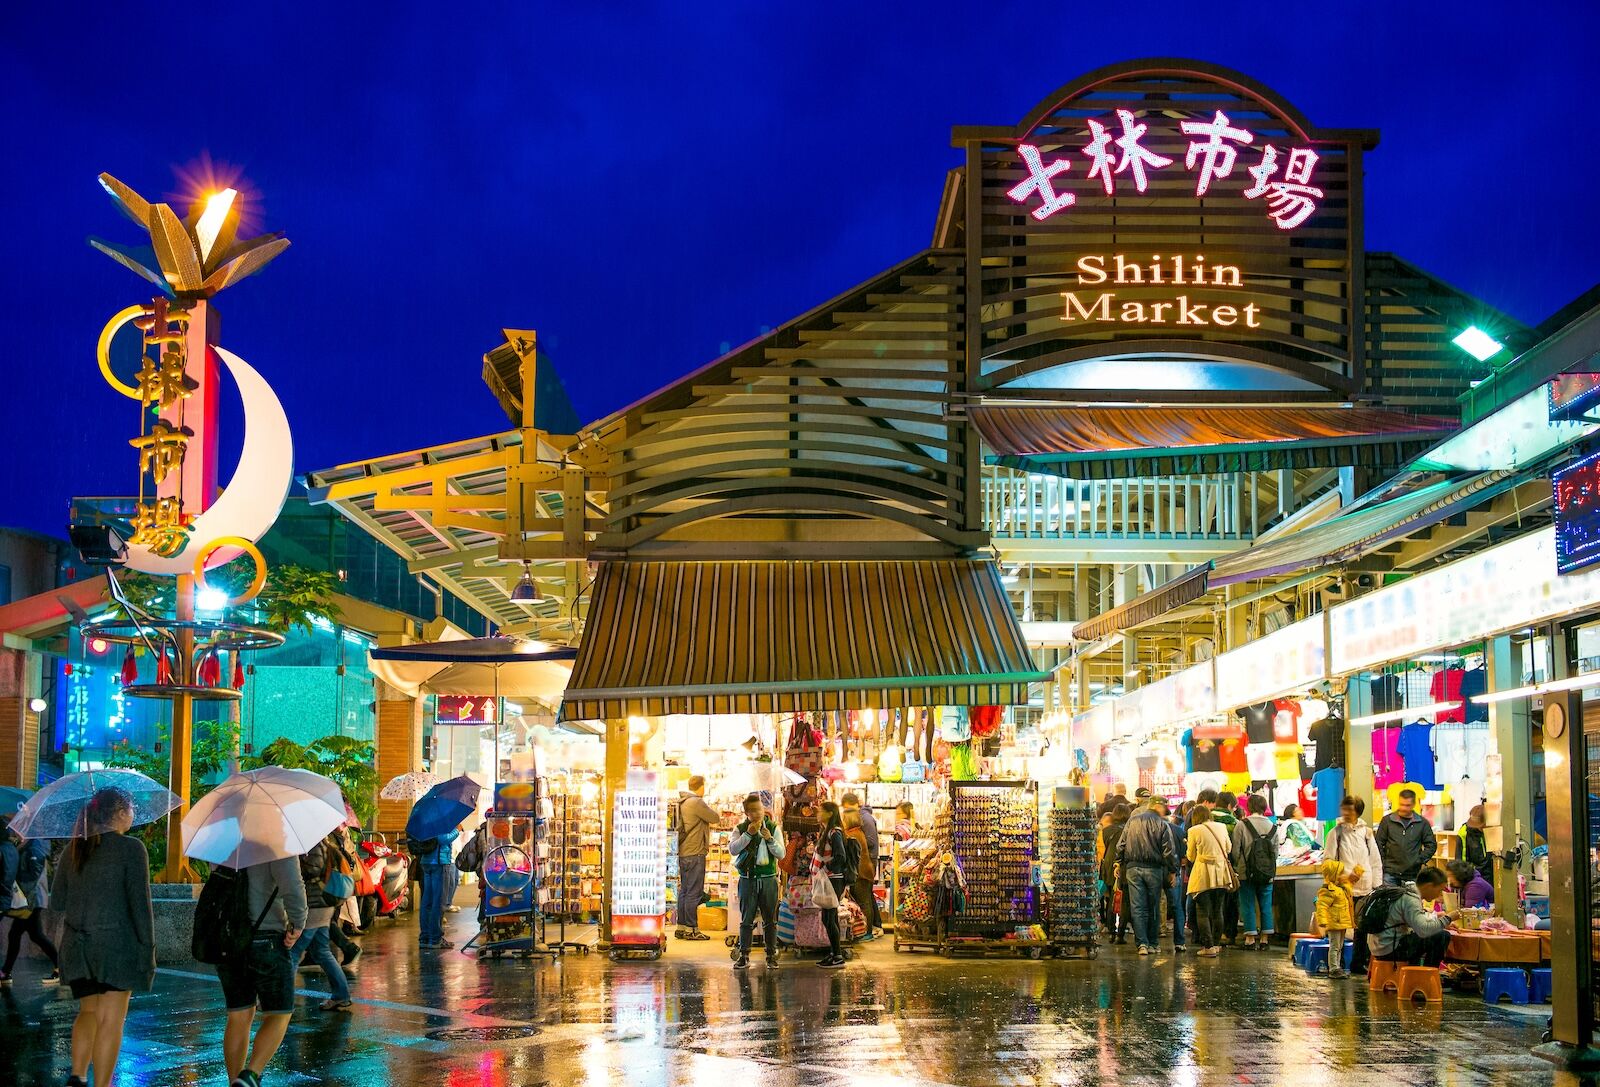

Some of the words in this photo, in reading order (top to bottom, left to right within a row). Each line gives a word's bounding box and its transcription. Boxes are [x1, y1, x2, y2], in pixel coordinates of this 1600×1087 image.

[1006, 108, 1324, 230] 士林市場
[1059, 291, 1261, 328] Market
[1077, 254, 1244, 287] Shilin
[128, 296, 193, 556] 士林市場
